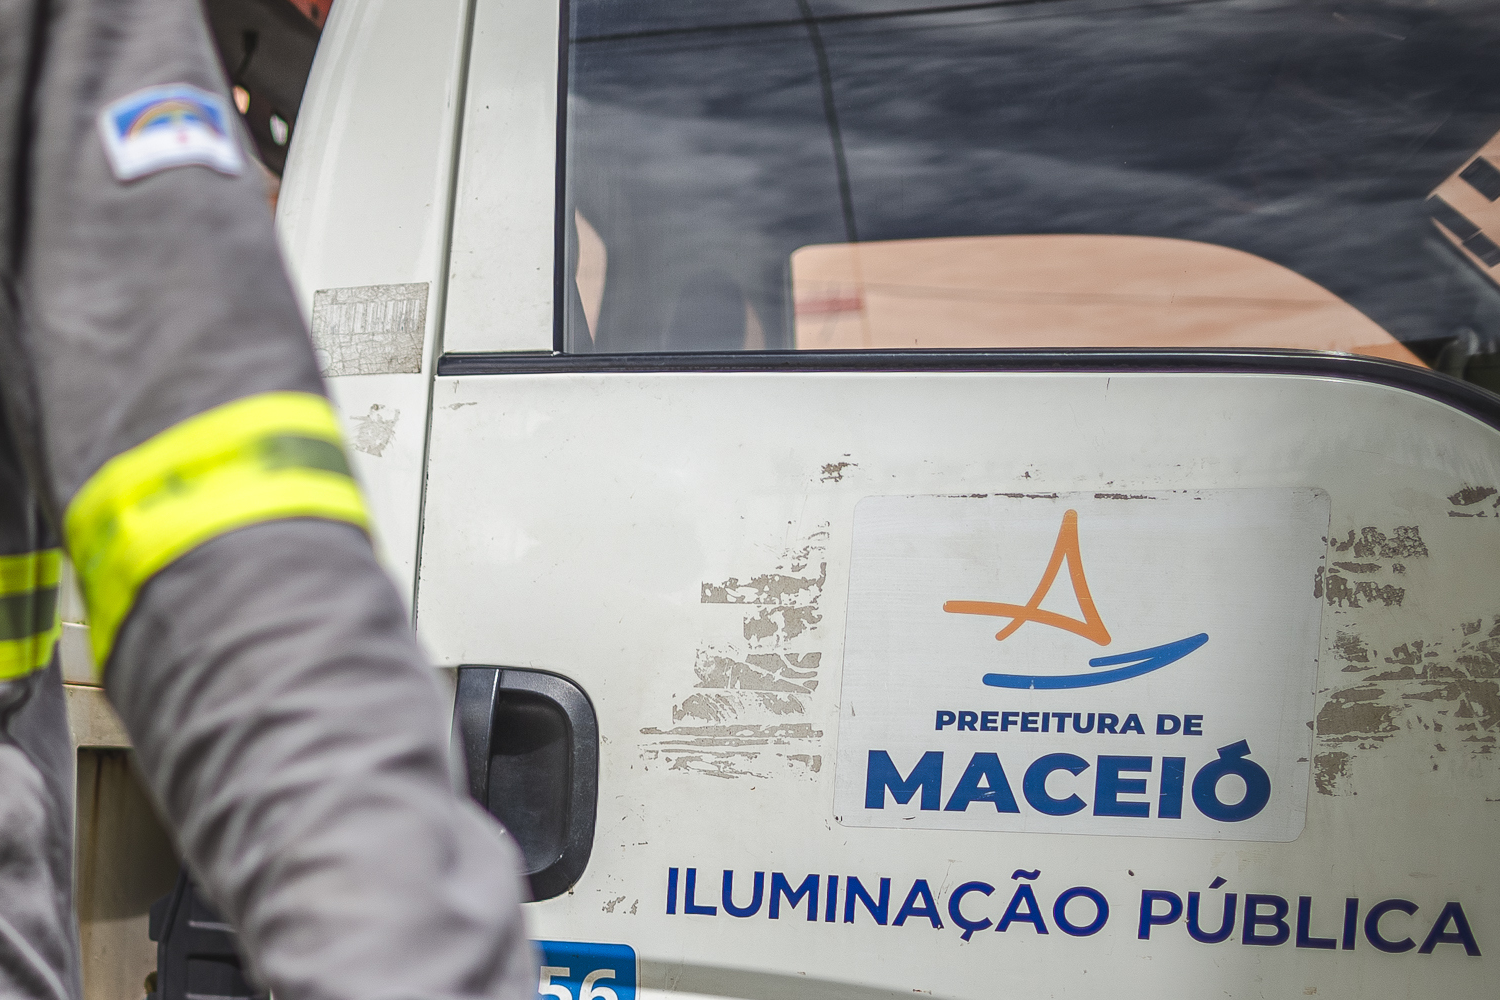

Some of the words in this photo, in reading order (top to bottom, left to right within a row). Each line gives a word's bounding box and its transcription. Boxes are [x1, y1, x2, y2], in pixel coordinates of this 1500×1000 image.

[934, 709, 1146, 736] PREFEITURA
[1155, 713, 1204, 737] DE
[864, 738, 1272, 823] MACEIÓ
[666, 867, 1110, 943] ILUMINAÇÃO
[1137, 876, 1482, 957] PÚBLICA
